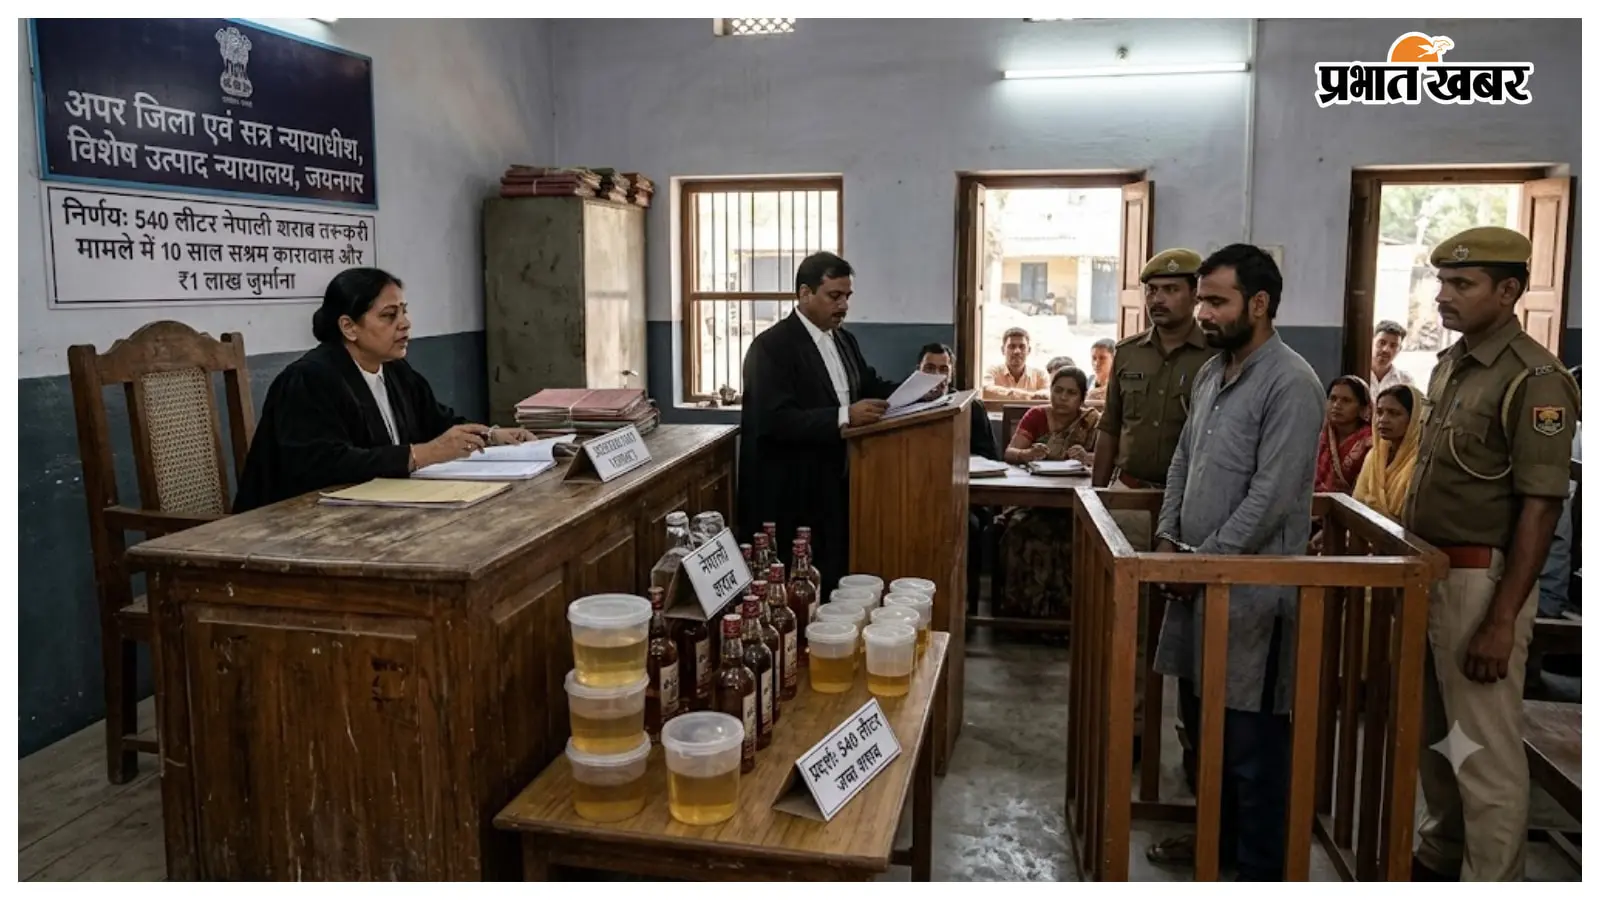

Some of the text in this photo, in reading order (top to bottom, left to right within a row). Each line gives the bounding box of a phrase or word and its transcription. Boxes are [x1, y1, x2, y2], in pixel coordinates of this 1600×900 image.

[64, 90, 363, 166] अपर जिला एवं सत्र न्यायाधीश,
[67, 125, 364, 194] विशेष उत्पाद न्यायालय, जयनगर
[135, 209, 169, 230] 540
[173, 206, 218, 233] लीटर
[222, 209, 272, 236] नेपाली
[276, 219, 315, 238] शराब
[75, 232, 364, 265] मामले में 10 साल सश्रम कारावास और
[178, 266, 296, 295] ₹1 लाख जुर्माना
[836, 732, 859, 758] 540
